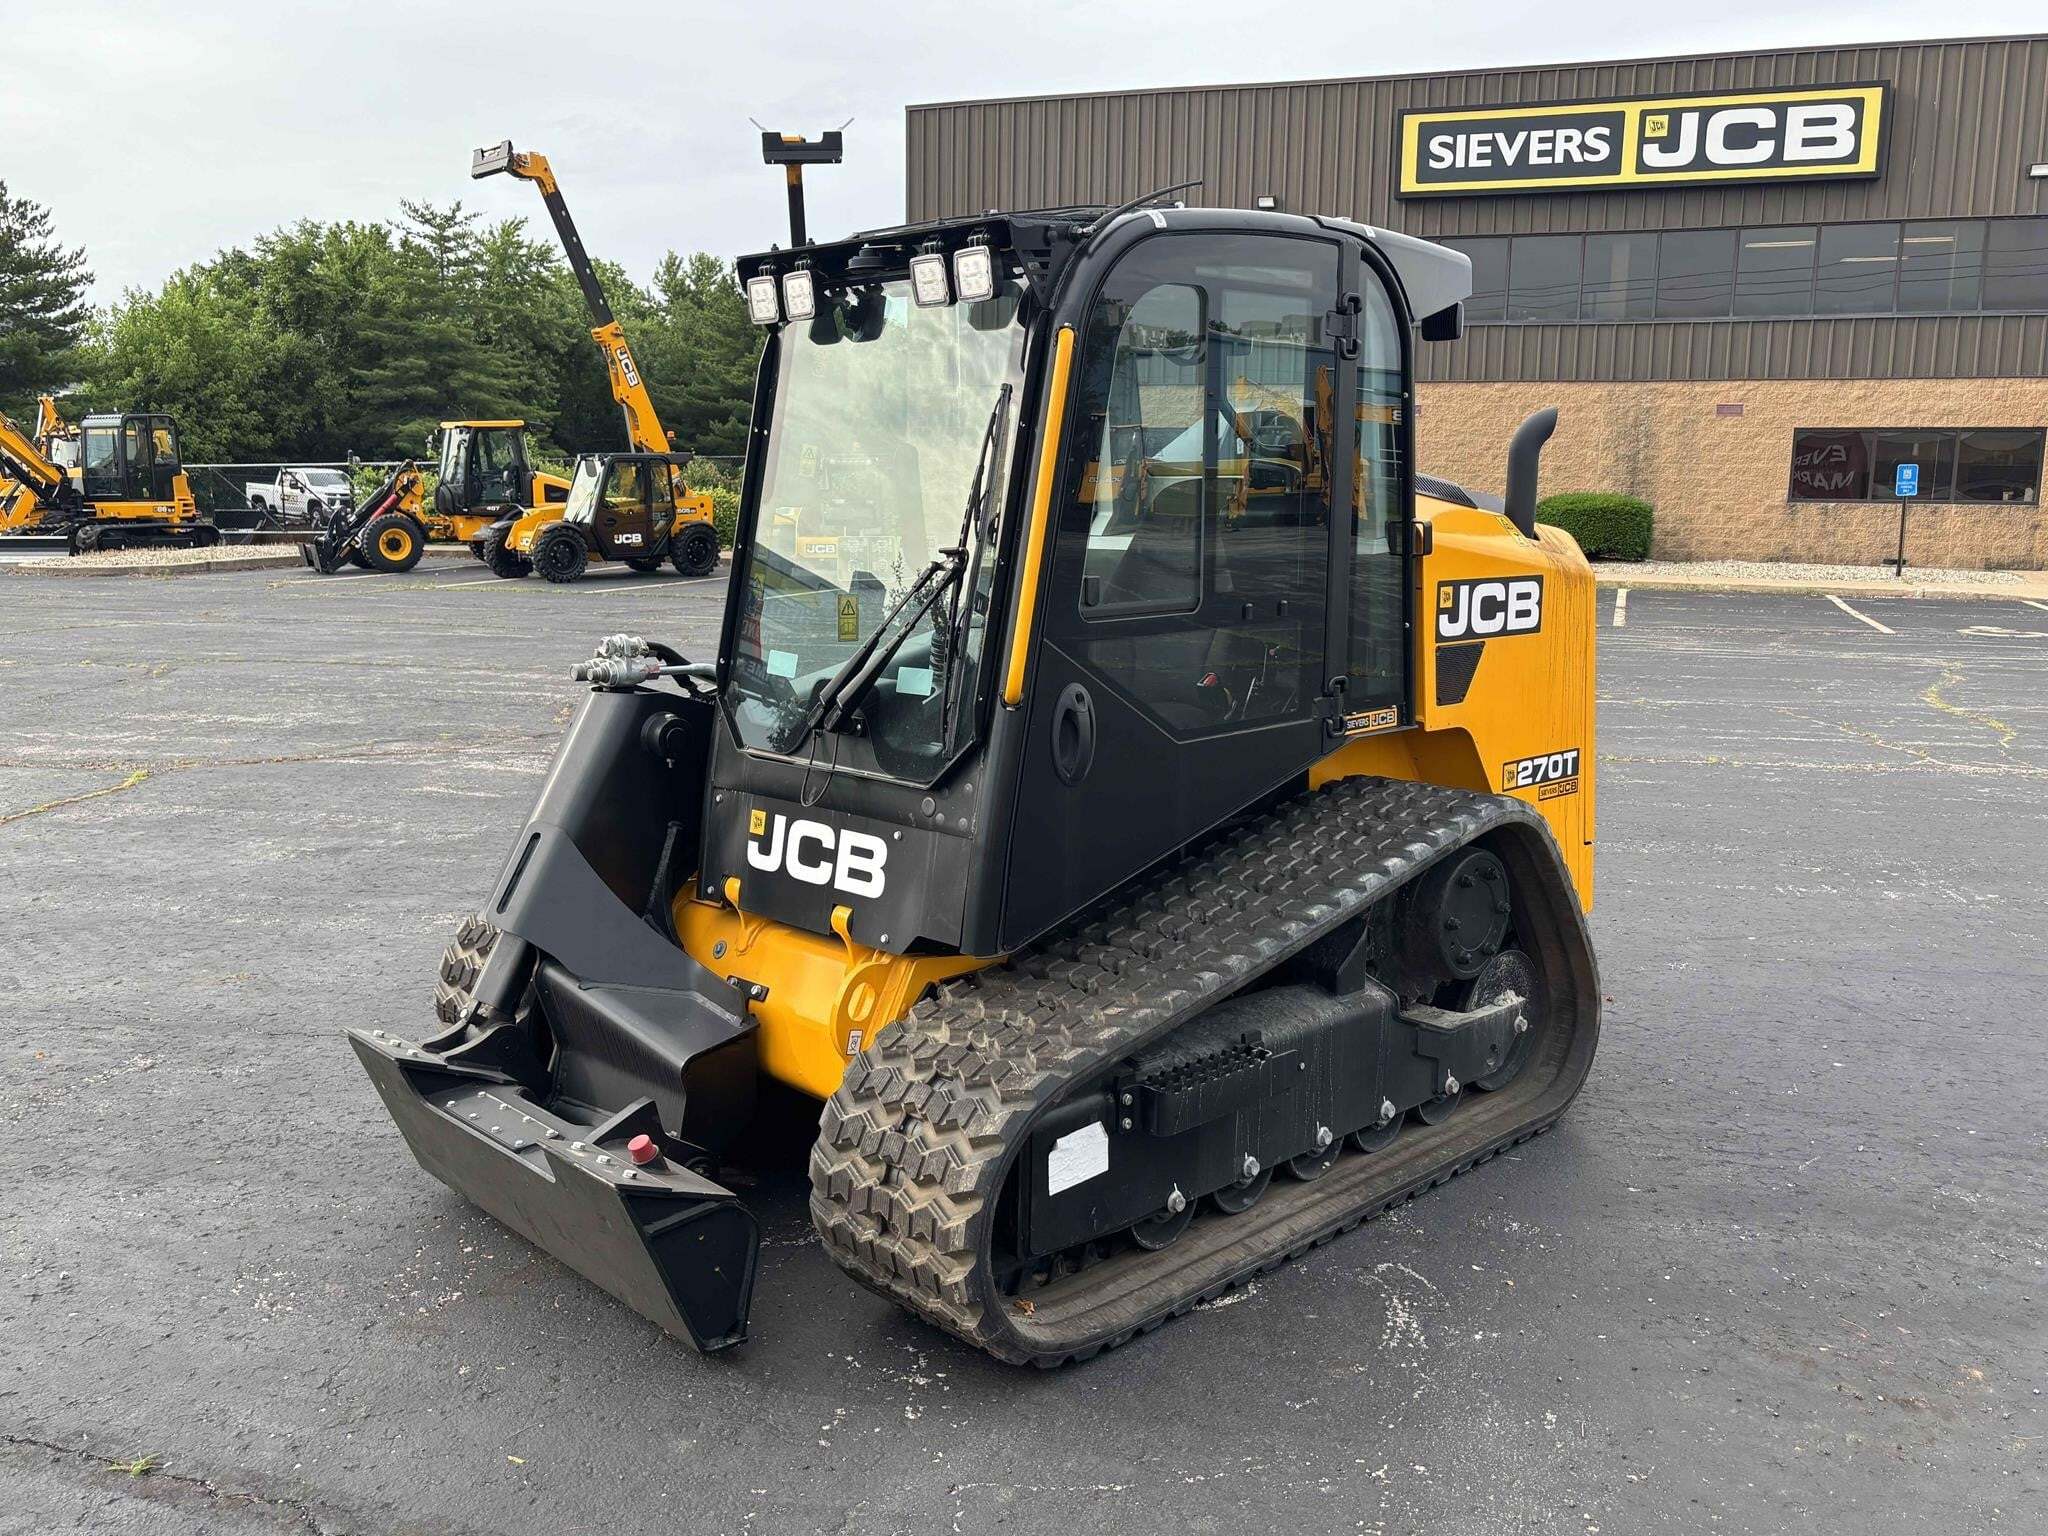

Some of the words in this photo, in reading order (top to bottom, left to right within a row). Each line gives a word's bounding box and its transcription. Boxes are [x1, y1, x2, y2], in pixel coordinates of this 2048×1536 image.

[1428, 126, 1611, 169] SIEVERS
[1642, 103, 1856, 167] JCB
[616, 347, 639, 387] JCB
[614, 533, 642, 544] JCB
[1438, 580, 1540, 637] JCB
[1372, 711, 1395, 725] JCB
[1517, 750, 1578, 787] 270T
[1559, 781, 1577, 793] JCB
[746, 813, 888, 899] JCB
